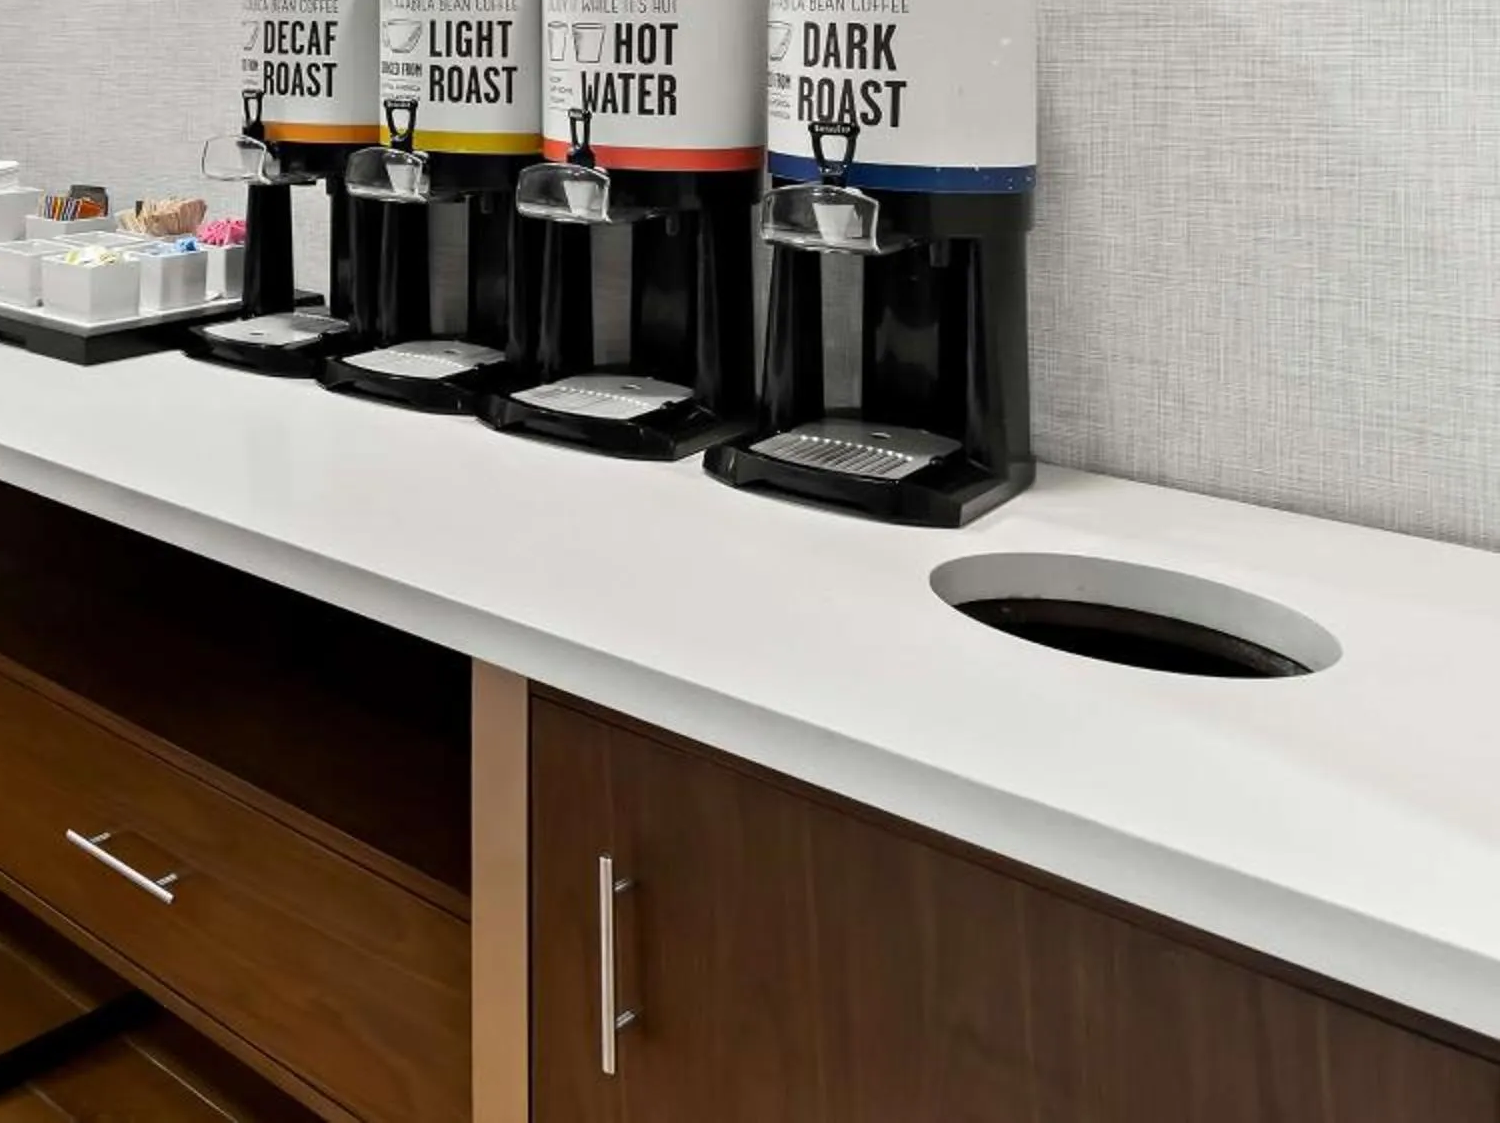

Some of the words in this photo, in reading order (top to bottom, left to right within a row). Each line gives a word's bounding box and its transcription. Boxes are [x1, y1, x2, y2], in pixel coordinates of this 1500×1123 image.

[263, 20, 339, 56] DECAF
[429, 19, 513, 58] LIGHT
[614, 22, 679, 66] HOT
[803, 21, 897, 71] DARK
[263, 60, 338, 98] ROAST
[429, 64, 518, 104] ROAST
[580, 71, 677, 116] WATER
[798, 76, 907, 128] ROAST
